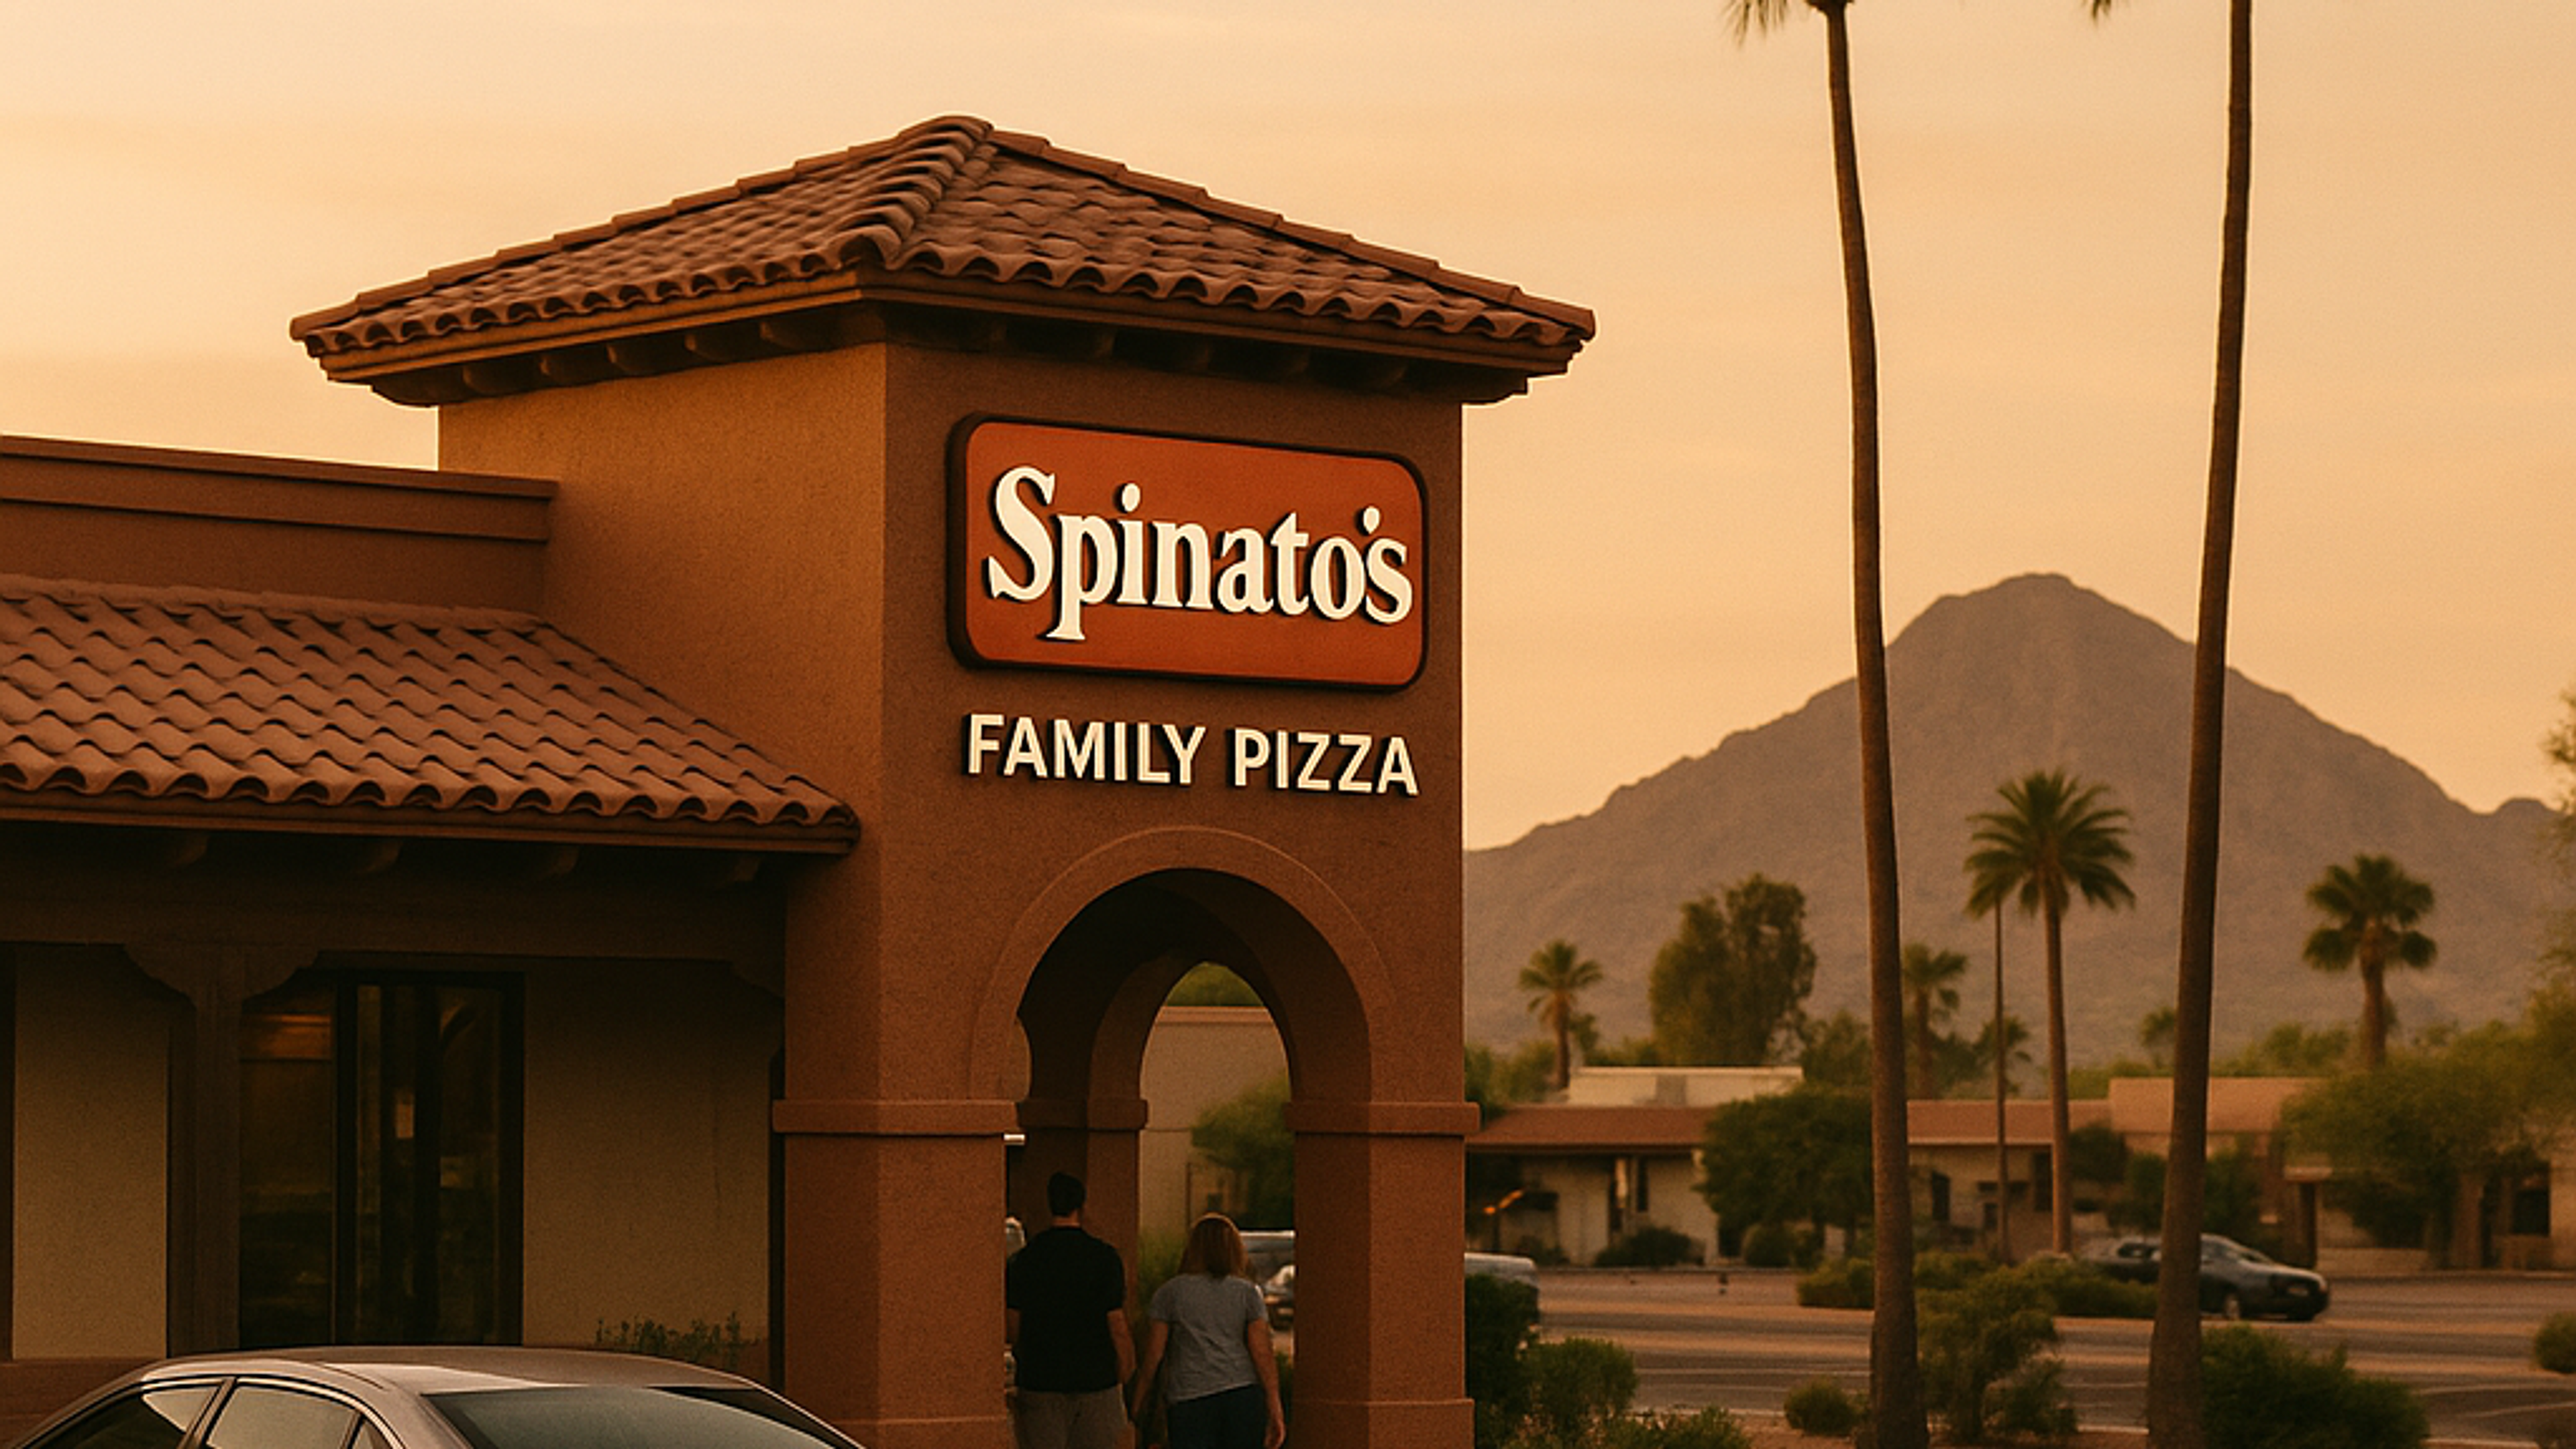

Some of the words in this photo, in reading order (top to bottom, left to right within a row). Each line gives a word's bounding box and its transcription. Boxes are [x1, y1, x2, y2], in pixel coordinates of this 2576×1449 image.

[986, 466, 1413, 641] Spinato's
[967, 713, 1207, 785] FAMILY
[1233, 727, 1419, 796] PIZZA
